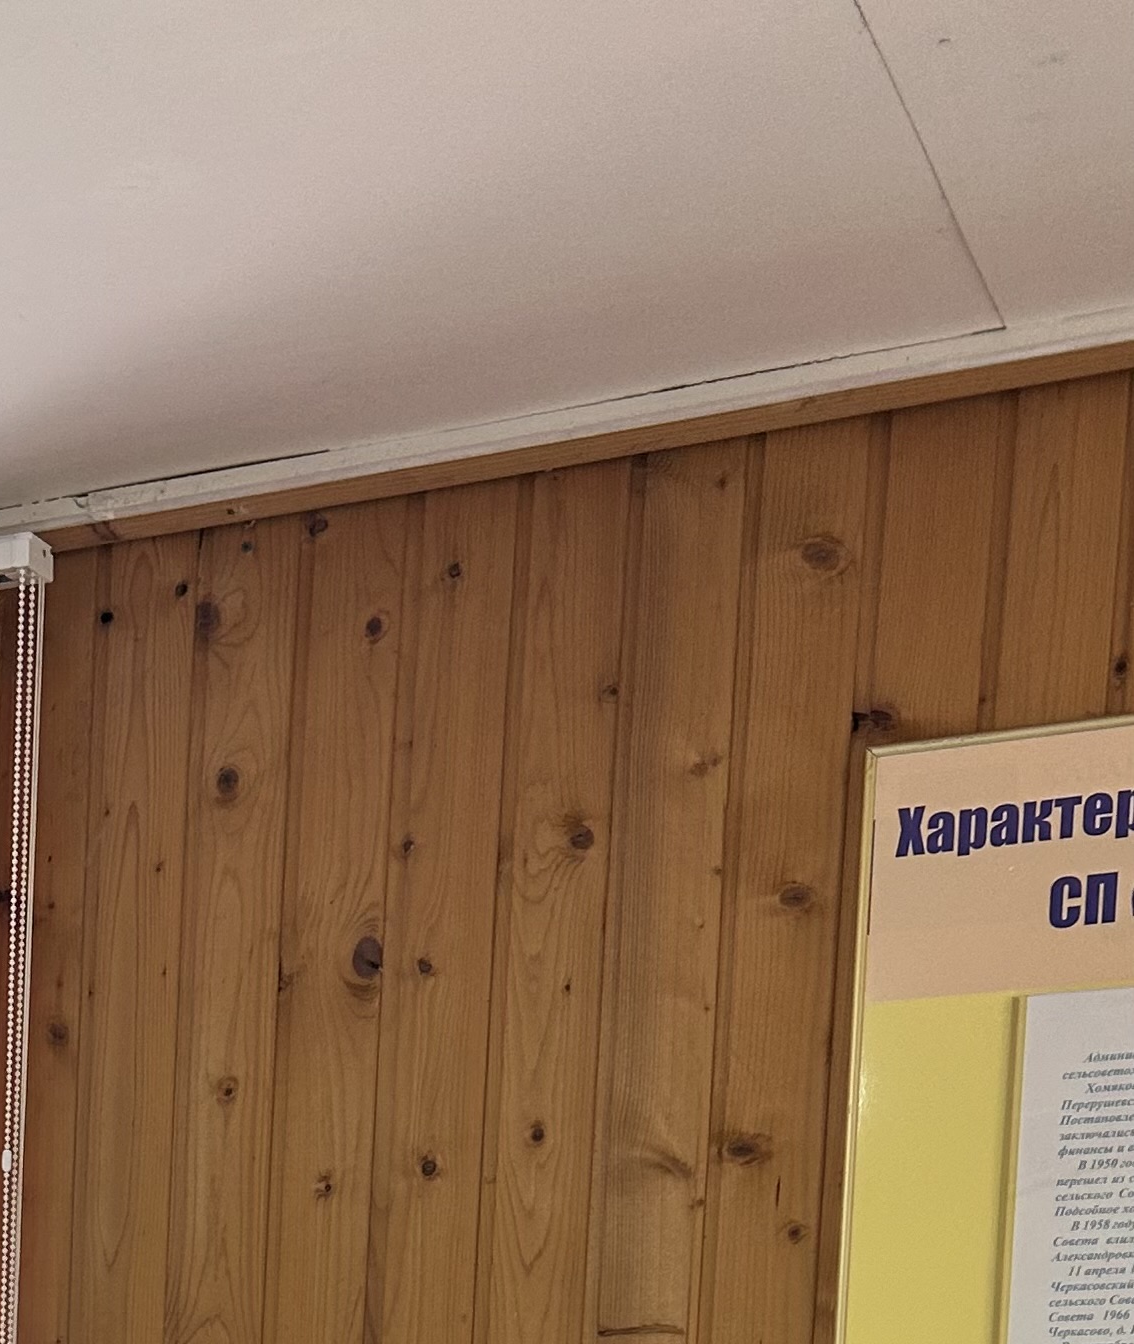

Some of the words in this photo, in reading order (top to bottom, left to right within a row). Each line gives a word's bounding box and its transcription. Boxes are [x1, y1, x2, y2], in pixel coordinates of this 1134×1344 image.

[1049, 871, 1119, 929] СП
[1083, 1051, 1134, 1064] Админи
[1057, 1145, 1113, 1160] финансы
[1077, 1159, 1087, 1171] В
[1090, 1158, 1118, 1170] 1950
[1056, 1175, 1108, 1190] перешел
[1055, 1190, 1113, 1203] сельского
[1070, 1220, 1080, 1232] В
[1083, 1219, 1110, 1231] 1958
[1053, 1236, 1099, 1248] Совета
[1068, 1265, 1082, 1277] 11
[1084, 1266, 1126, 1279] апреля
[1049, 1298, 1106, 1308] сельского
[1049, 1311, 1094, 1323] Совета
[1103, 1309, 1130, 1321] 1966
